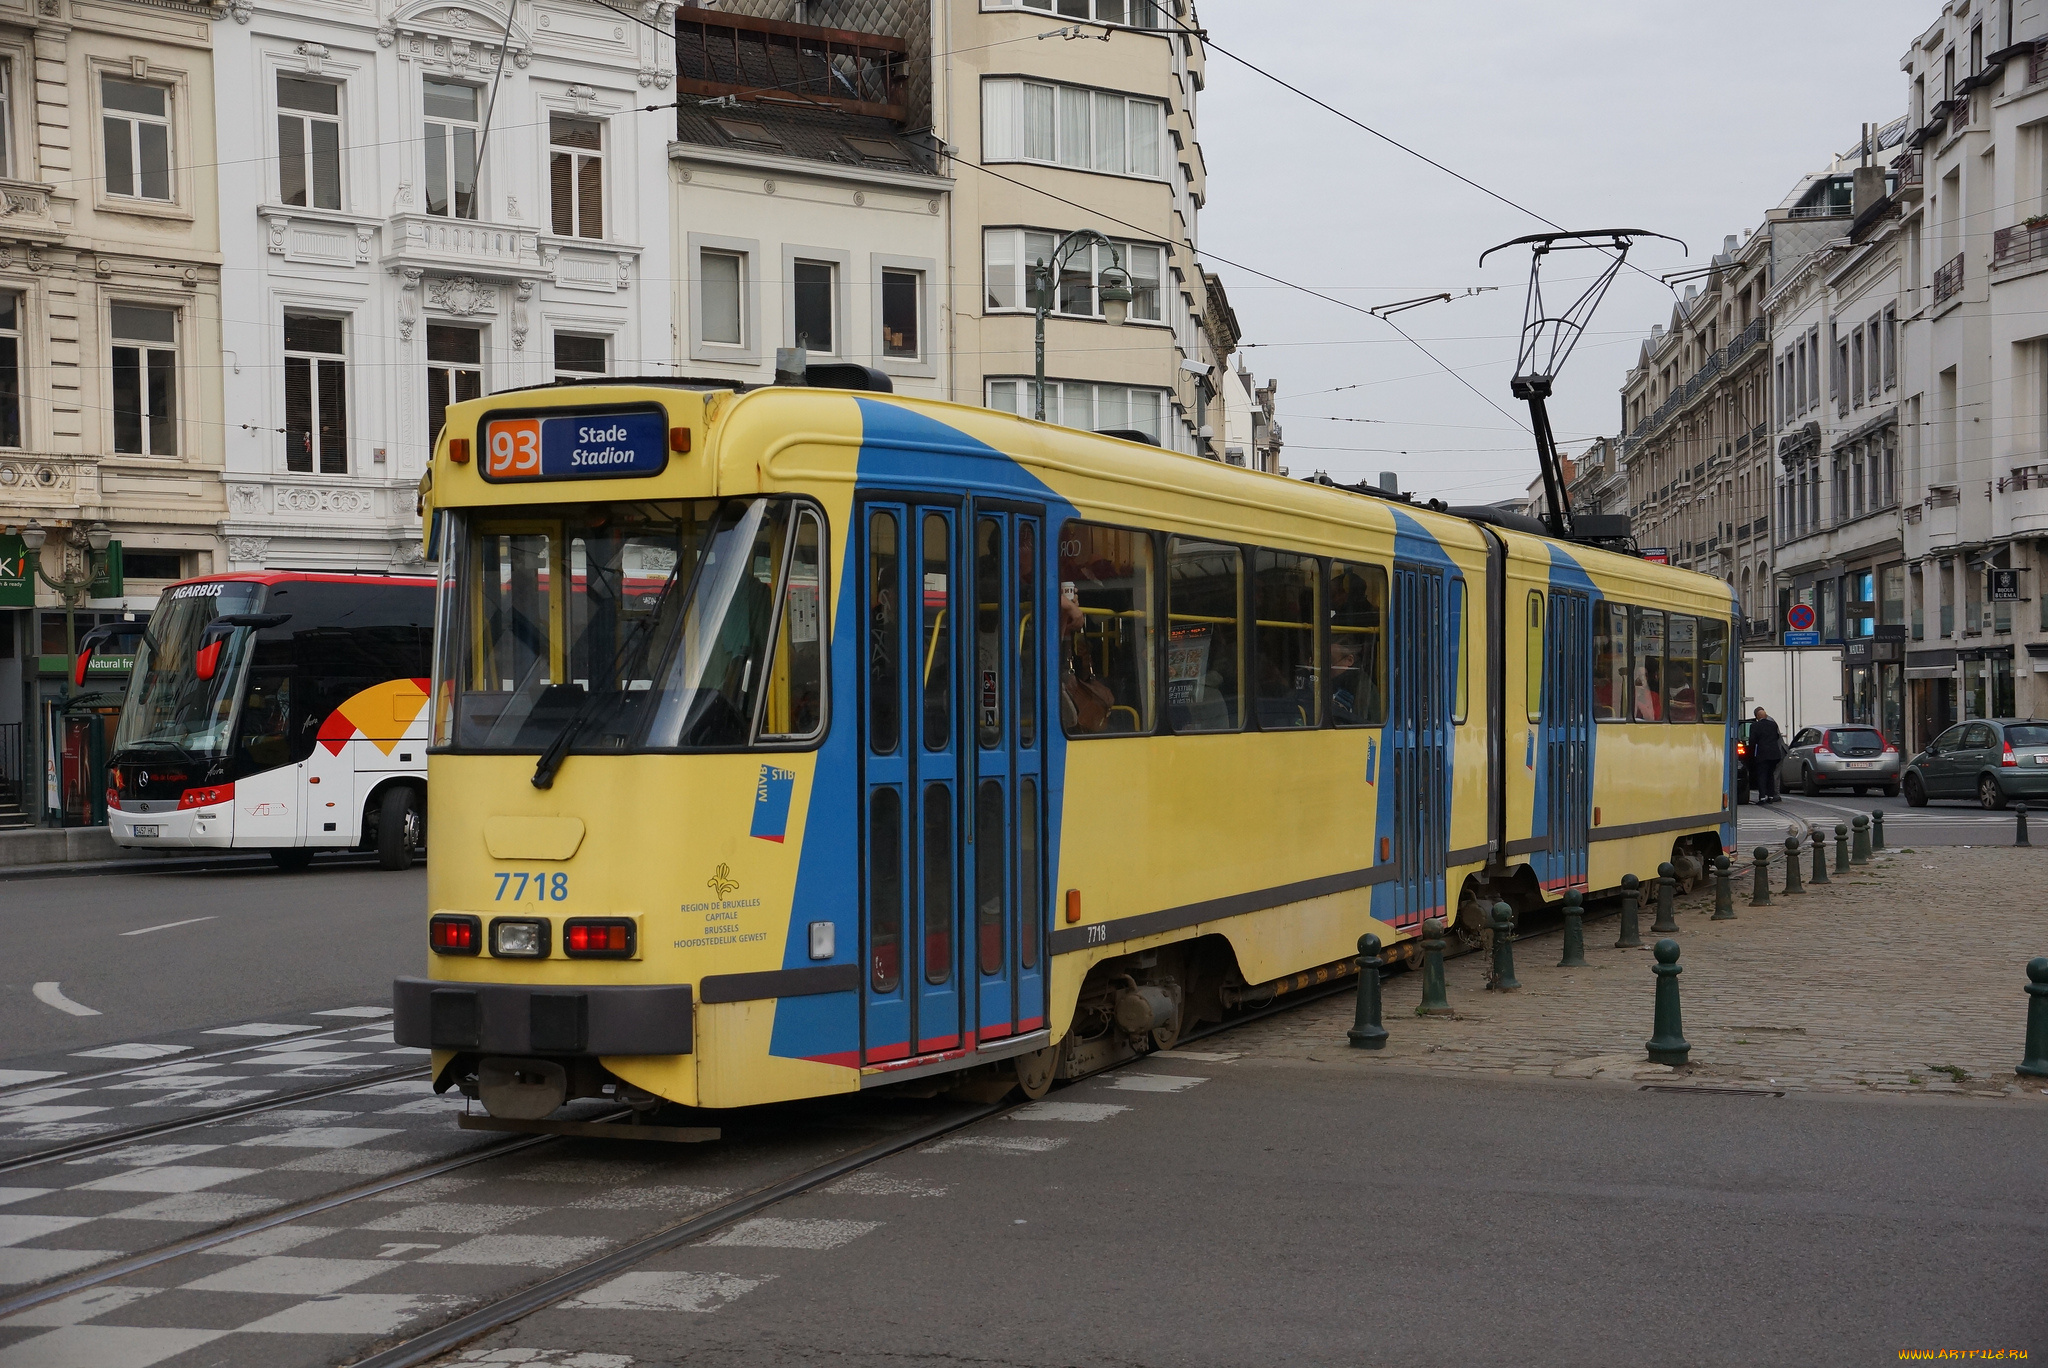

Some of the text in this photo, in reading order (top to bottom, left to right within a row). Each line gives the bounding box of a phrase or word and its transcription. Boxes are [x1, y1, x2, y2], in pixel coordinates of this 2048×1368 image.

[579, 425, 627, 444] Stade
[492, 430, 538, 470] 93
[571, 449, 634, 466] Stadion
[171, 584, 225, 600] AGARBUS
[89, 659, 120, 669] Natural
[771, 768, 794, 780] STIB
[758, 766, 768, 802] MIVB
[494, 872, 568, 901] 7718
[681, 898, 760, 912] REGION DE BRUXELLES
[705, 911, 738, 922] CAPITALE
[704, 924, 739, 935] BRUSSELS
[738, 932, 767, 943] GEWEST
[1087, 924, 1106, 943] 7718
